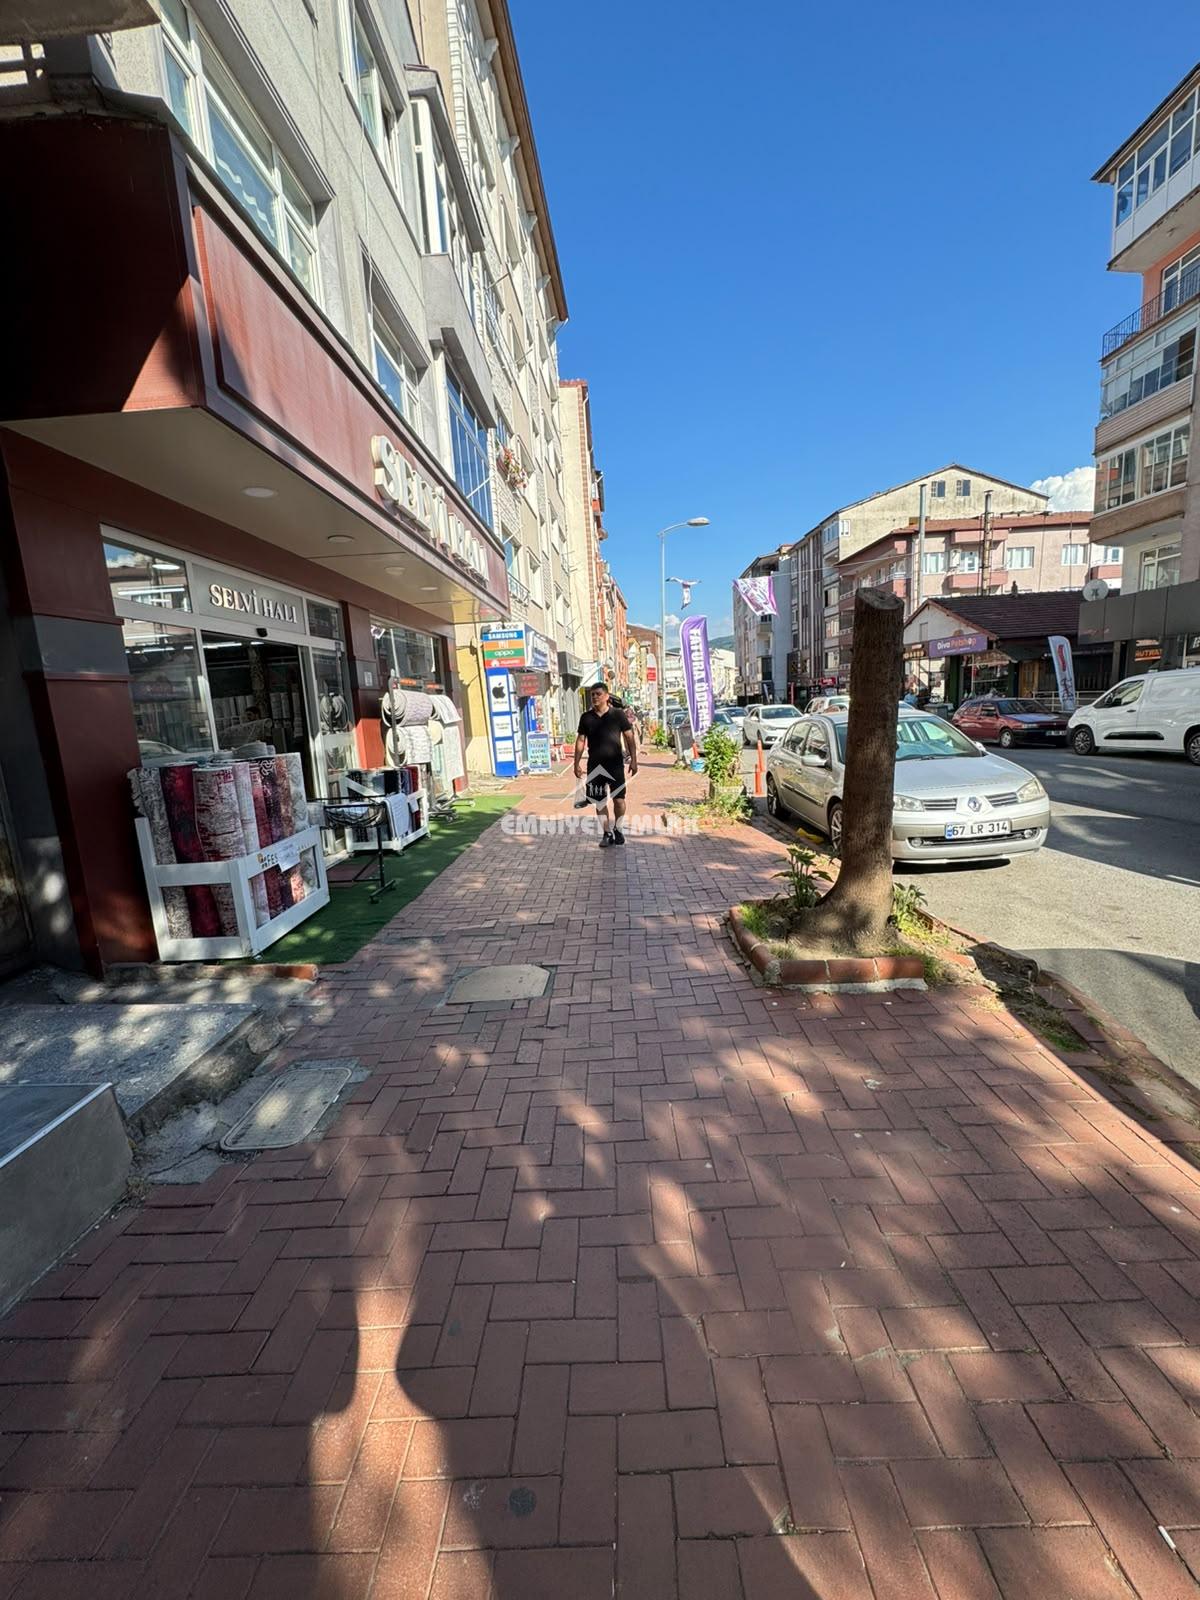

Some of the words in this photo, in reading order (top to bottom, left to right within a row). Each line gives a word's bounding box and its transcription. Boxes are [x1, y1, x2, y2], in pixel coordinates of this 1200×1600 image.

[209, 583, 260, 616] SELVİ
[261, 597, 298, 624] HALI
[689, 628, 707, 680] FATURA
[936, 641, 951, 651] Diva
[951, 825, 966, 837] 67
[970, 824, 984, 835] LR
[988, 822, 1008, 833] 314
